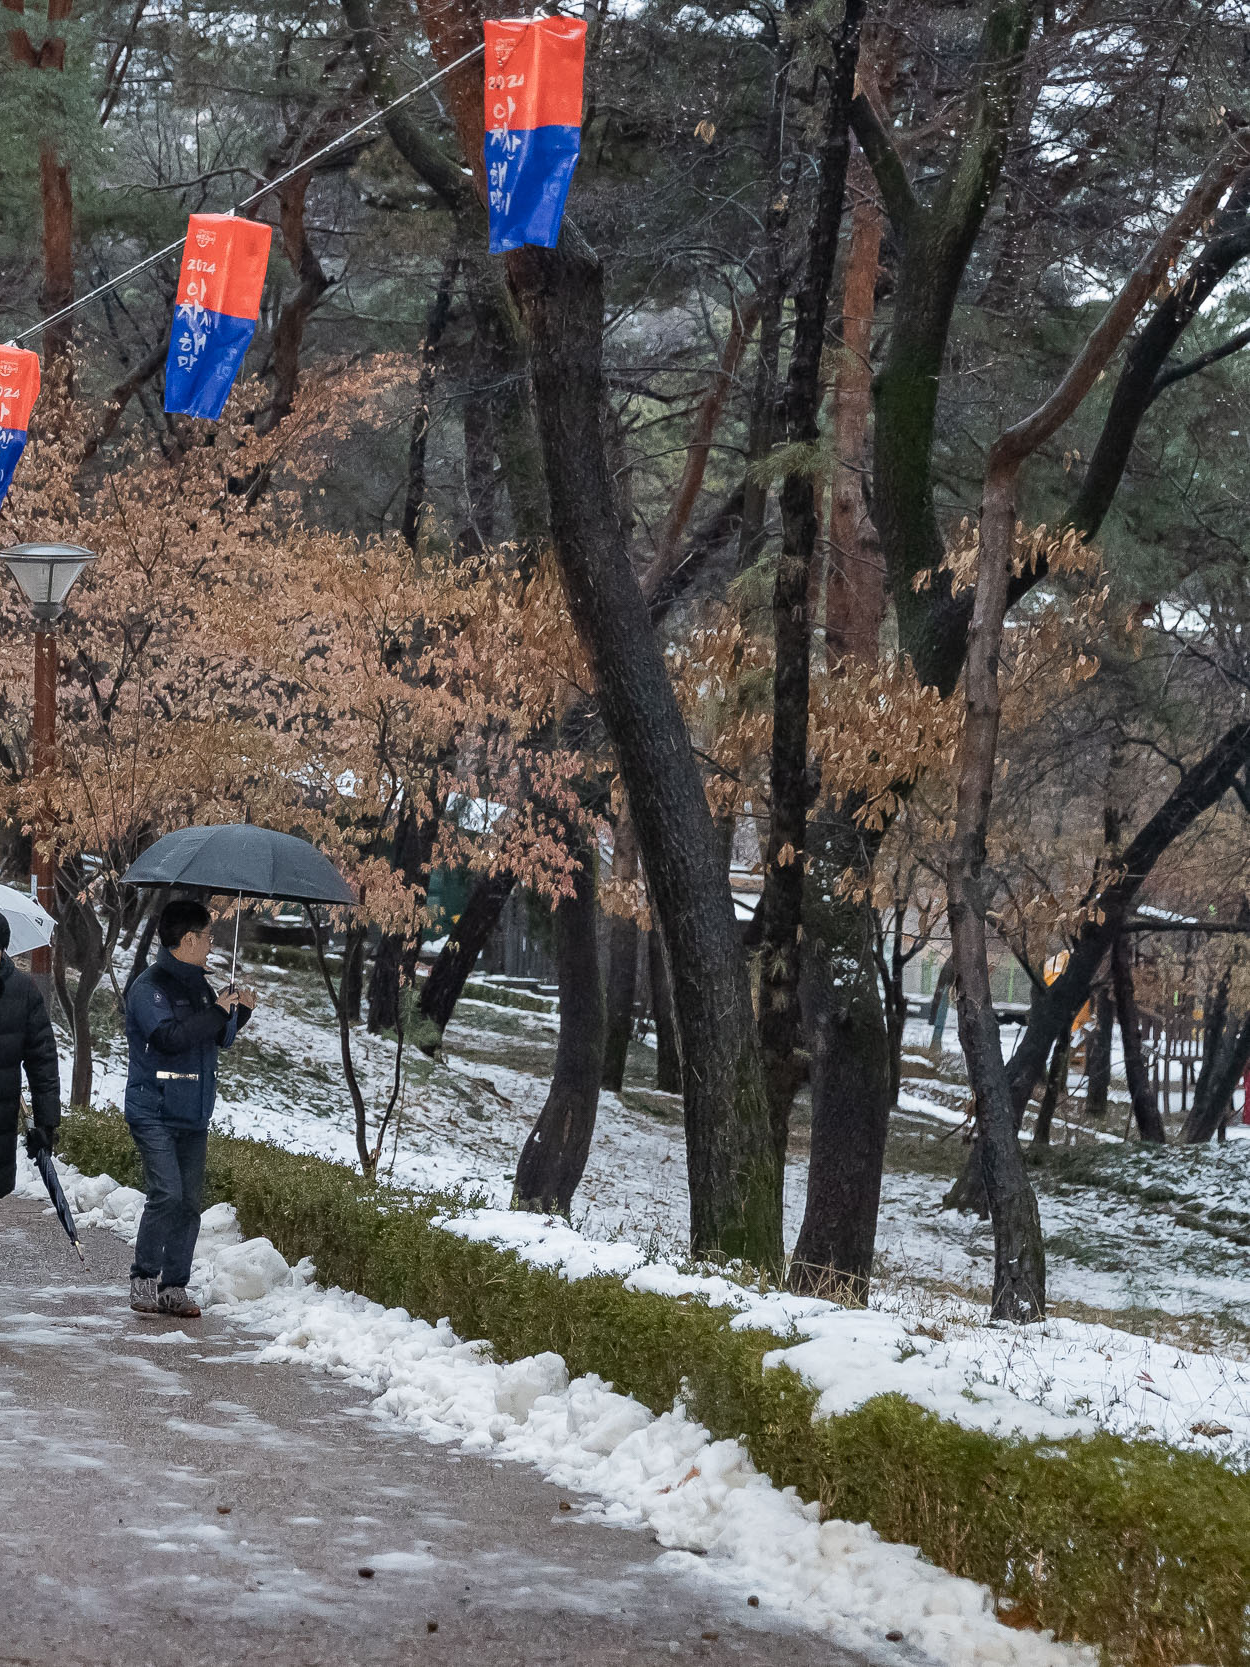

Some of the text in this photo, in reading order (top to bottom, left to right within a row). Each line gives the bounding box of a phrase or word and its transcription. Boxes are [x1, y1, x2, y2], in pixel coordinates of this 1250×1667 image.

[489, 96, 523, 161] 아차산
[186, 258, 217, 275] 2024
[177, 278, 213, 334] 아차산
[178, 332, 207, 373] 해맞
